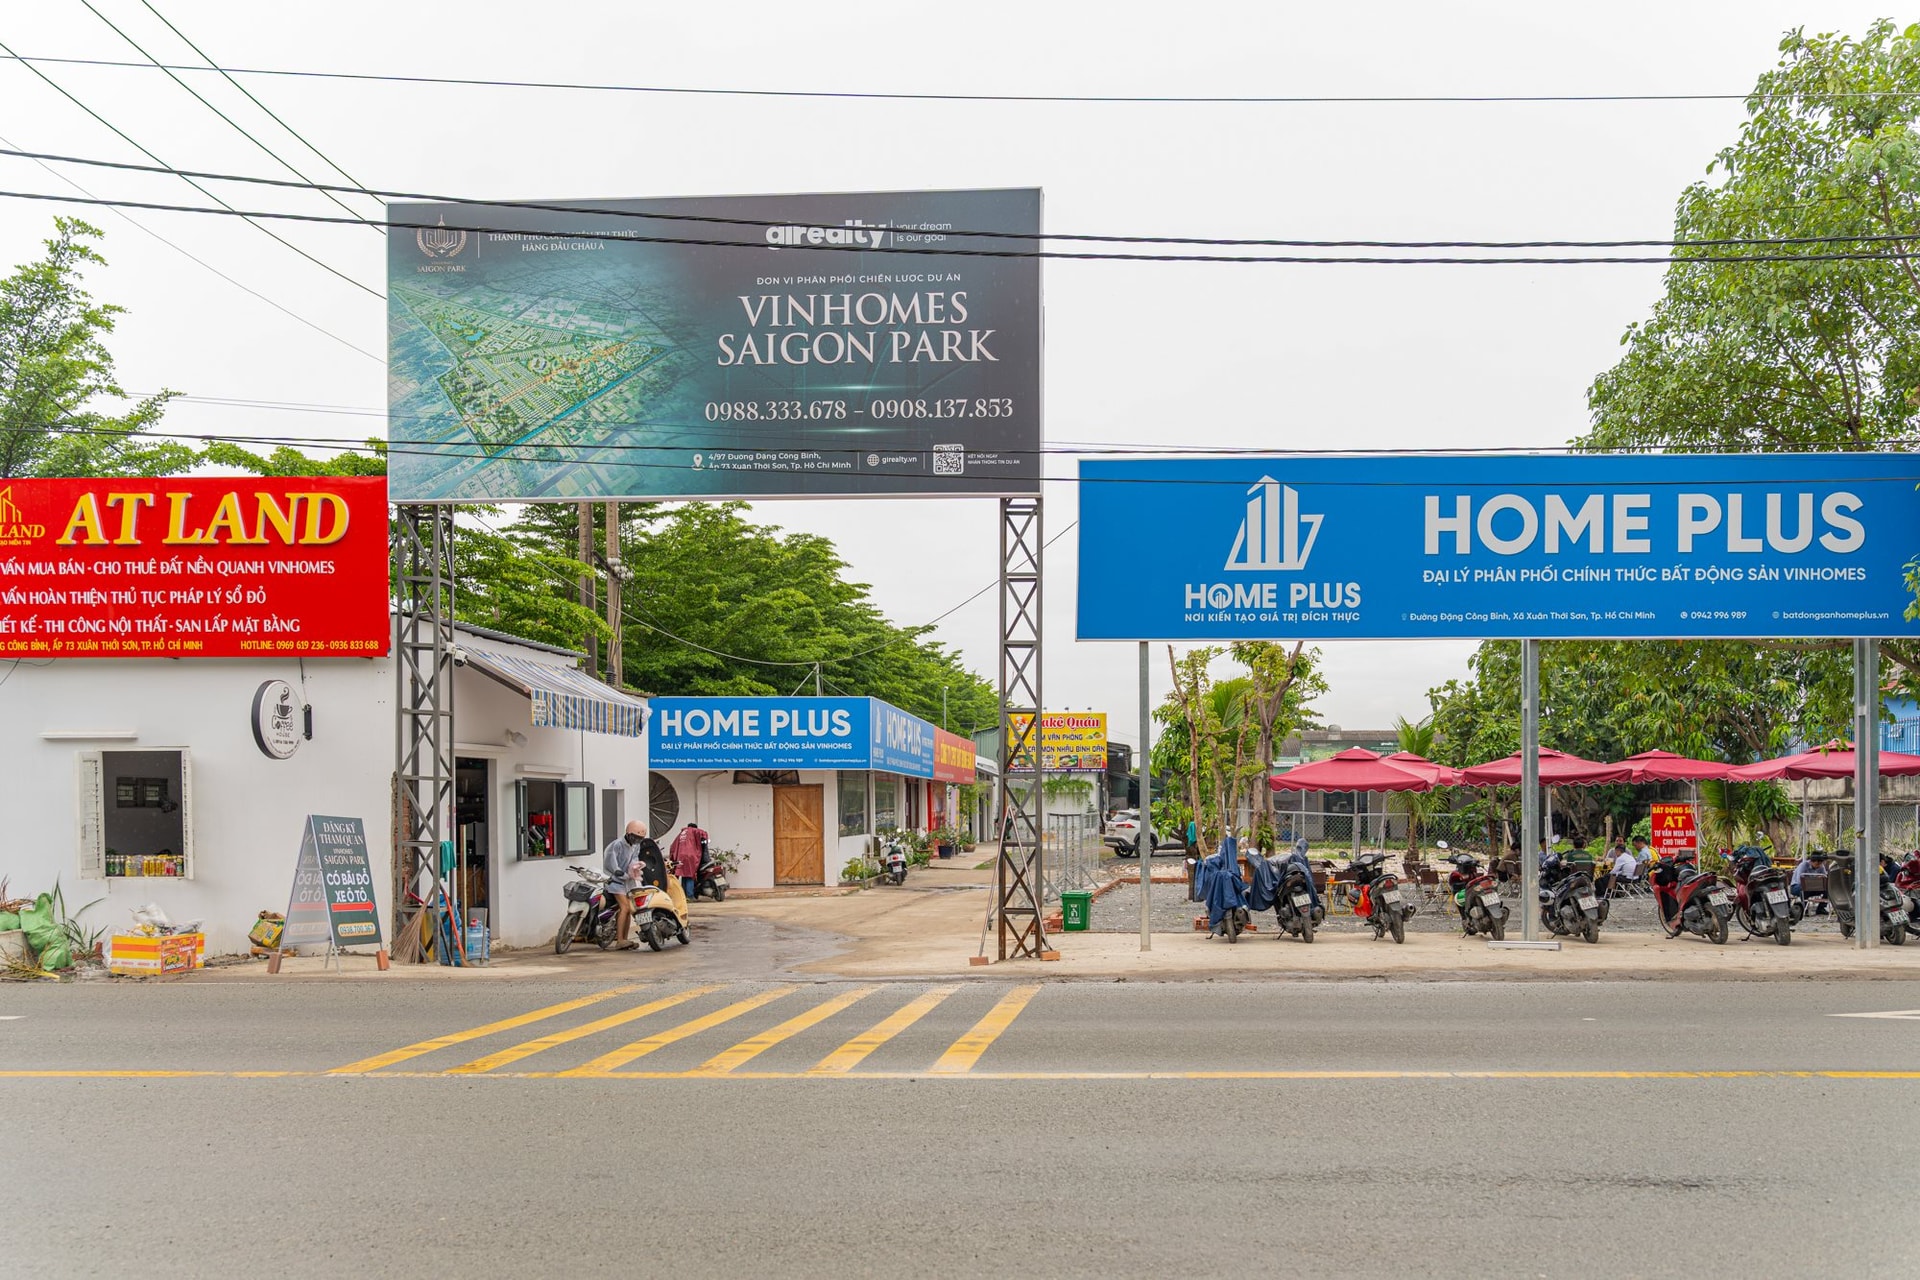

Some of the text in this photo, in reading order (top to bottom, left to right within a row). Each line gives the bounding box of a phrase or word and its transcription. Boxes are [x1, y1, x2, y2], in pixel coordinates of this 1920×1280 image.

[919, 222, 952, 231] dream
[906, 234, 922, 242] our
[522, 243, 548, 252] HÀNG
[551, 242, 569, 251] ĐẦU
[571, 241, 596, 250] CHÂU
[417, 265, 445, 273] SAIGON
[757, 276, 780, 285] ĐƠN
[797, 275, 826, 284] PHÂN
[830, 274, 856, 283] PHỐI
[859, 273, 892, 283] CHIẾN
[946, 273, 961, 282] ÁN
[738, 291, 969, 328] VINHOMES
[717, 329, 1000, 366] SAIGON PARK
[705, 398, 1014, 421] 0988.333.678 0908.137.853
[882, 456, 917, 465] girealty.vn
[56, 491, 350, 545] AT LAND
[1424, 492, 1866, 555] HOME PLUS
[0, 555, 335, 576] VẤN MUA BÁN CHO THUÊ ĐẤT NỀN QUANH VINHOMES
[1422, 564, 1866, 586] ĐẠI LÝ PHÂN PHỐI CHÍNH THỨC BẤT ĐỘNG SẢN VINHOMES
[2, 584, 267, 607] VẤN HOÀN THIỆN THỦ TỤC PHÁP LÝ SỔ ĐỎ
[1185, 582, 1361, 609] HOME PLUS
[1185, 610, 1360, 624] NƠI KIẾN TẠO GIÁ TRỊ ĐÍCH THỰC
[1410, 610, 1889, 622] Đường Đặng Công Bình, Xã Xuân Thới Sơn, Tp. Hồ Chí Minh 0942 996 989 batdongsanhomeplus.vn
[21, 613, 300, 636] KẾ THI CÔNG NỘI THẤT SAN LẤP MẶT BẰNG
[8, 637, 379, 651] CÔNG BÌNH, ẤP 73 XUÂN THỚI SƠN, TP. HỒ CHÍ MINH HOTLINE: 0969 619 236 0936 833 688
[661, 708, 852, 737] HOME PLUS
[1067, 716, 1100, 730] Quán
[887, 709, 921, 756] HOME PLUS
[661, 741, 852, 751] ĐẠI LÝ PHÂN PHỐI CHÍNH THỨC BẤT ĐỘNG SẢN VINHOMES
[323, 821, 356, 834] ĐĂNG KÝ
[1664, 816, 1686, 828] AT
[319, 834, 364, 846] THAM QUAN
[323, 855, 365, 865] SAIGON PARK
[327, 868, 370, 886] CÓ BÃI ĐỖ
[335, 887, 367, 902] XE Ô TÔ
